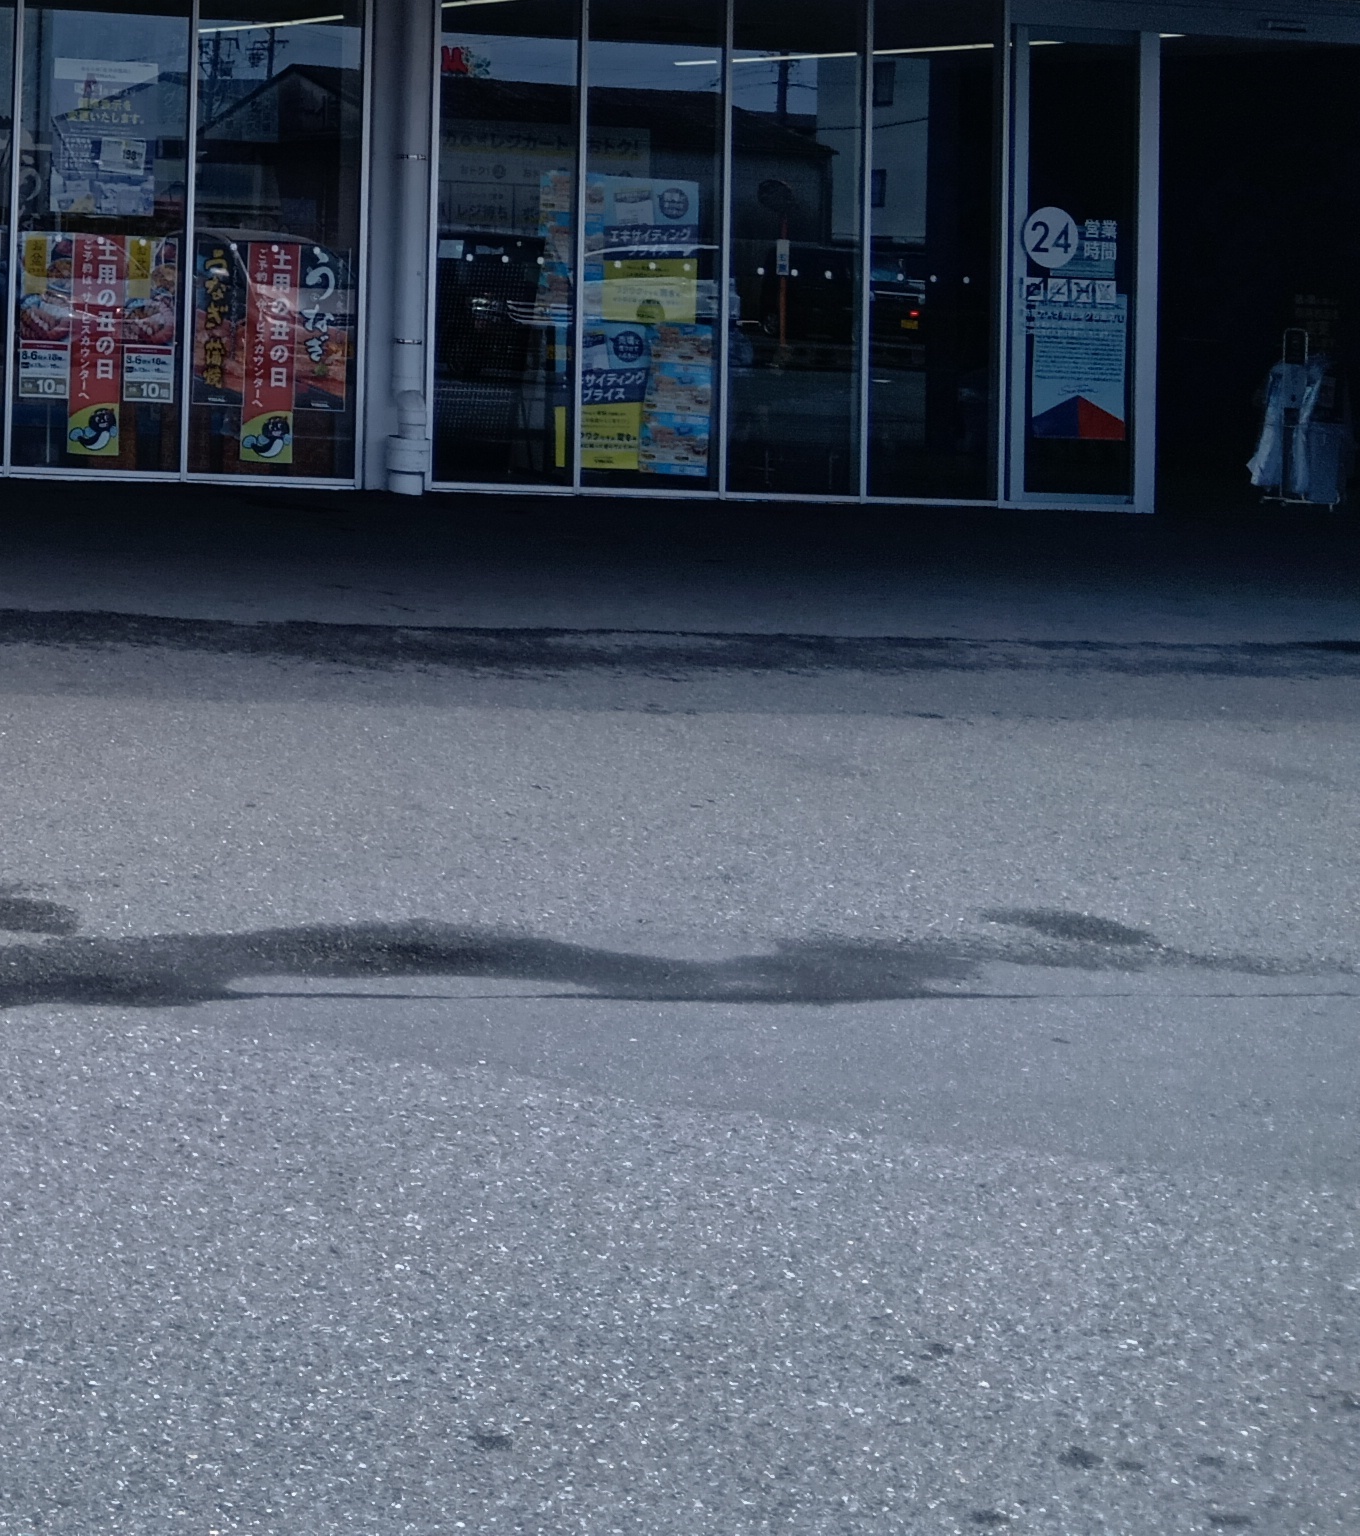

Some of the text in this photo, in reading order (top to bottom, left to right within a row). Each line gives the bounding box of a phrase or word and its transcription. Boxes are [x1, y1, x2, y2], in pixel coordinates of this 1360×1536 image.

[610, 227, 692, 243] エキサイティング
[1031, 220, 1072, 254] 24
[1084, 219, 1118, 239] 営業
[1083, 241, 1117, 261] 時間
[95, 240, 118, 380] 土用の丑の日
[300, 246, 336, 363] うなぎ
[270, 249, 292, 388] 土用の丑の日
[581, 369, 646, 387] サイティング
[583, 387, 626, 402] プライス
